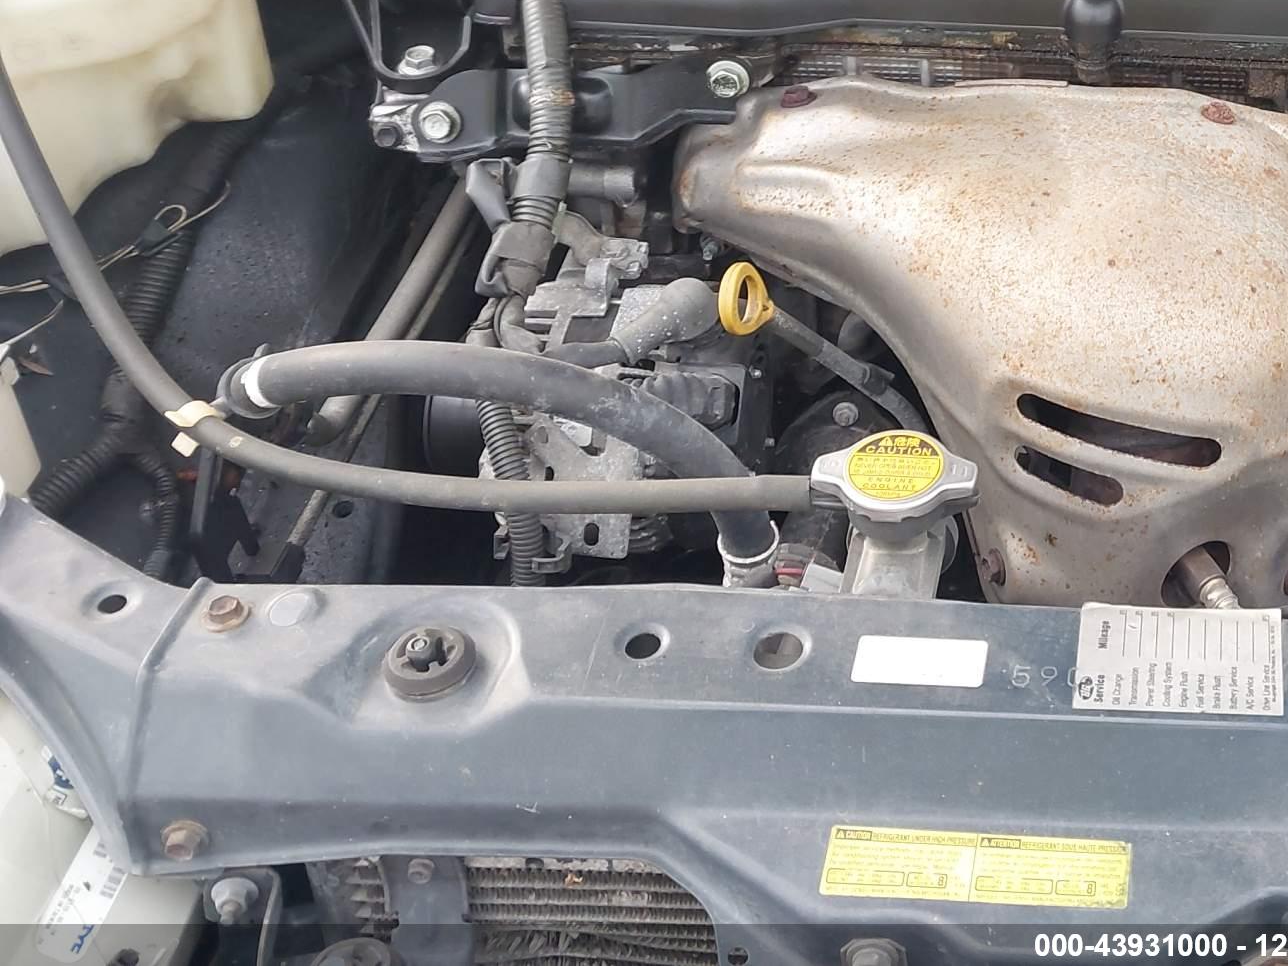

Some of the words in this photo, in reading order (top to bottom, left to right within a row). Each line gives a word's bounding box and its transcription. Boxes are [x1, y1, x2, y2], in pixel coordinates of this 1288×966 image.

[865, 445, 932, 456] CAUTION
[1098, 620, 1111, 649] Mileage
[1093, 675, 1105, 703] Service
[1129, 667, 1139, 706] Transmission
[1196, 674, 1205, 695] Service
[1229, 666, 1238, 688] Service
